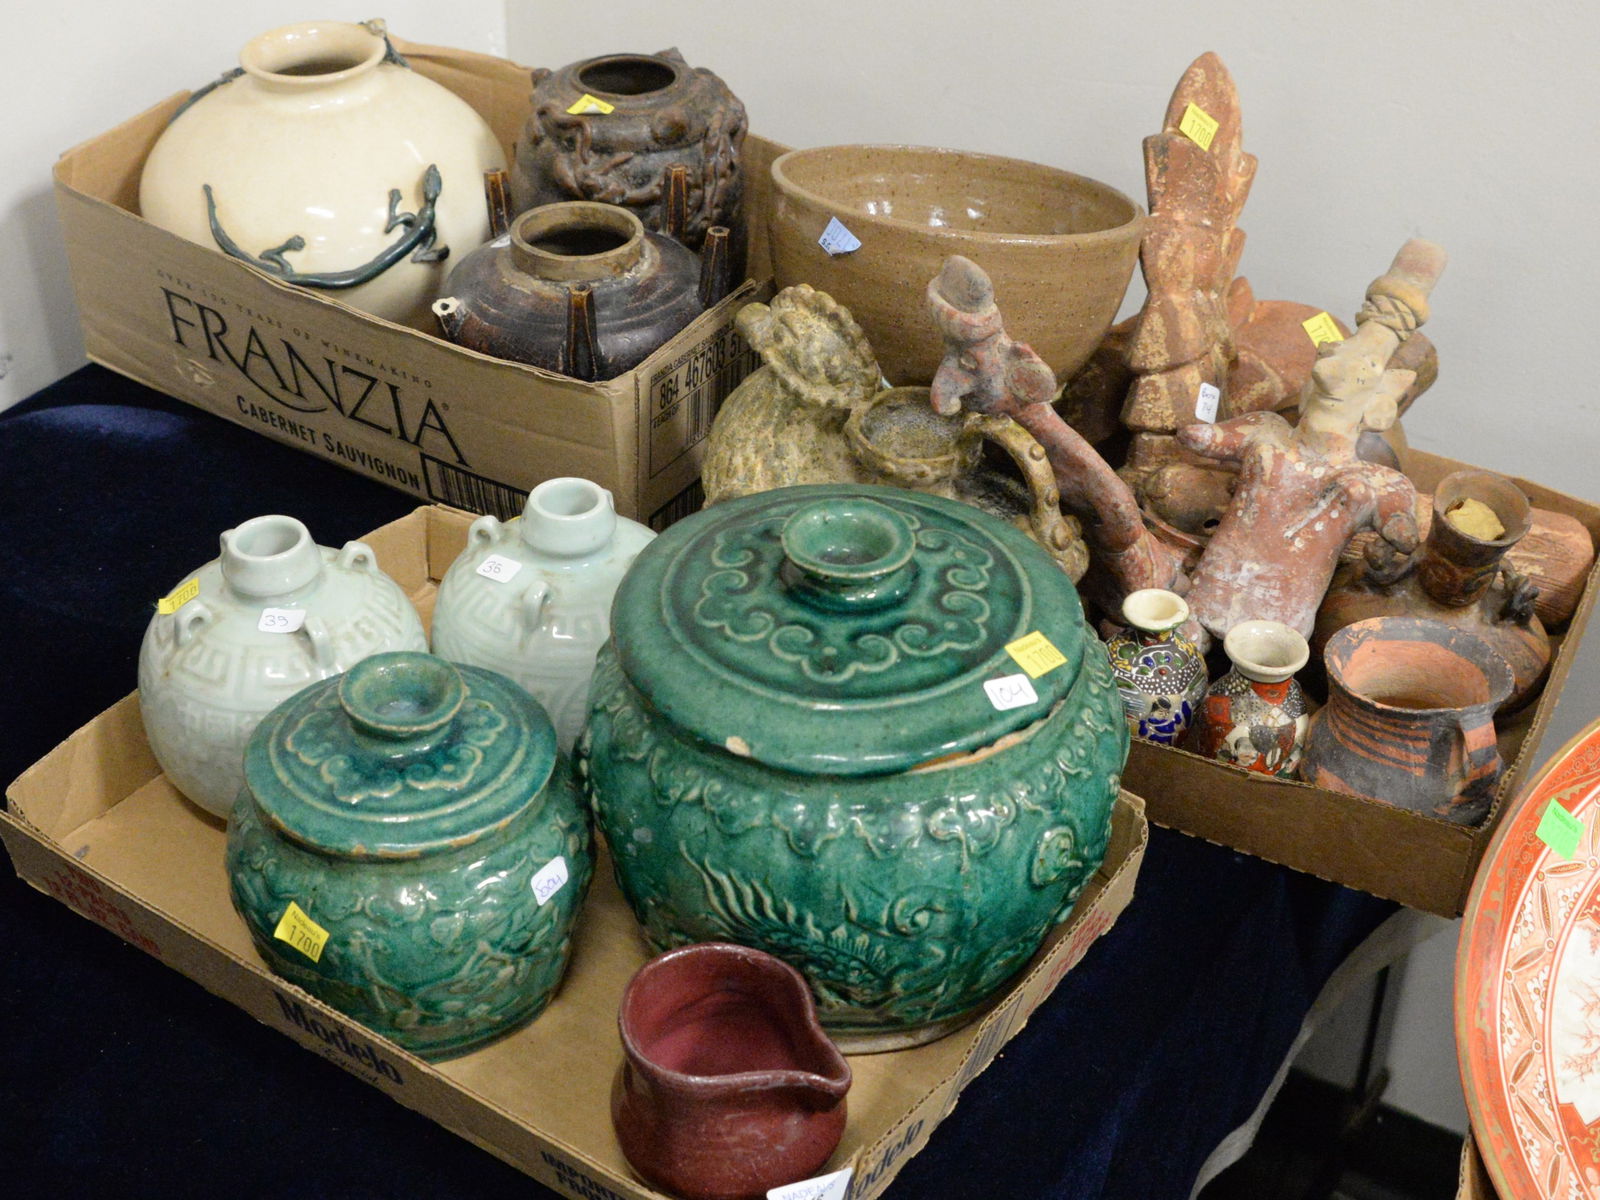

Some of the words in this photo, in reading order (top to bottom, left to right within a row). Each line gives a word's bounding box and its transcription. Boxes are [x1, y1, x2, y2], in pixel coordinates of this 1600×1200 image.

[160, 286, 473, 468] FRANZIA
[321, 339, 432, 389] WINEMAKING
[660, 373, 679, 409] 864
[685, 337, 725, 391] 467603
[236, 394, 316, 444] CABERNET
[322, 432, 421, 490] SAUVIGNON
[289, 924, 320, 958] 1700
[273, 989, 403, 1085] Modelo
